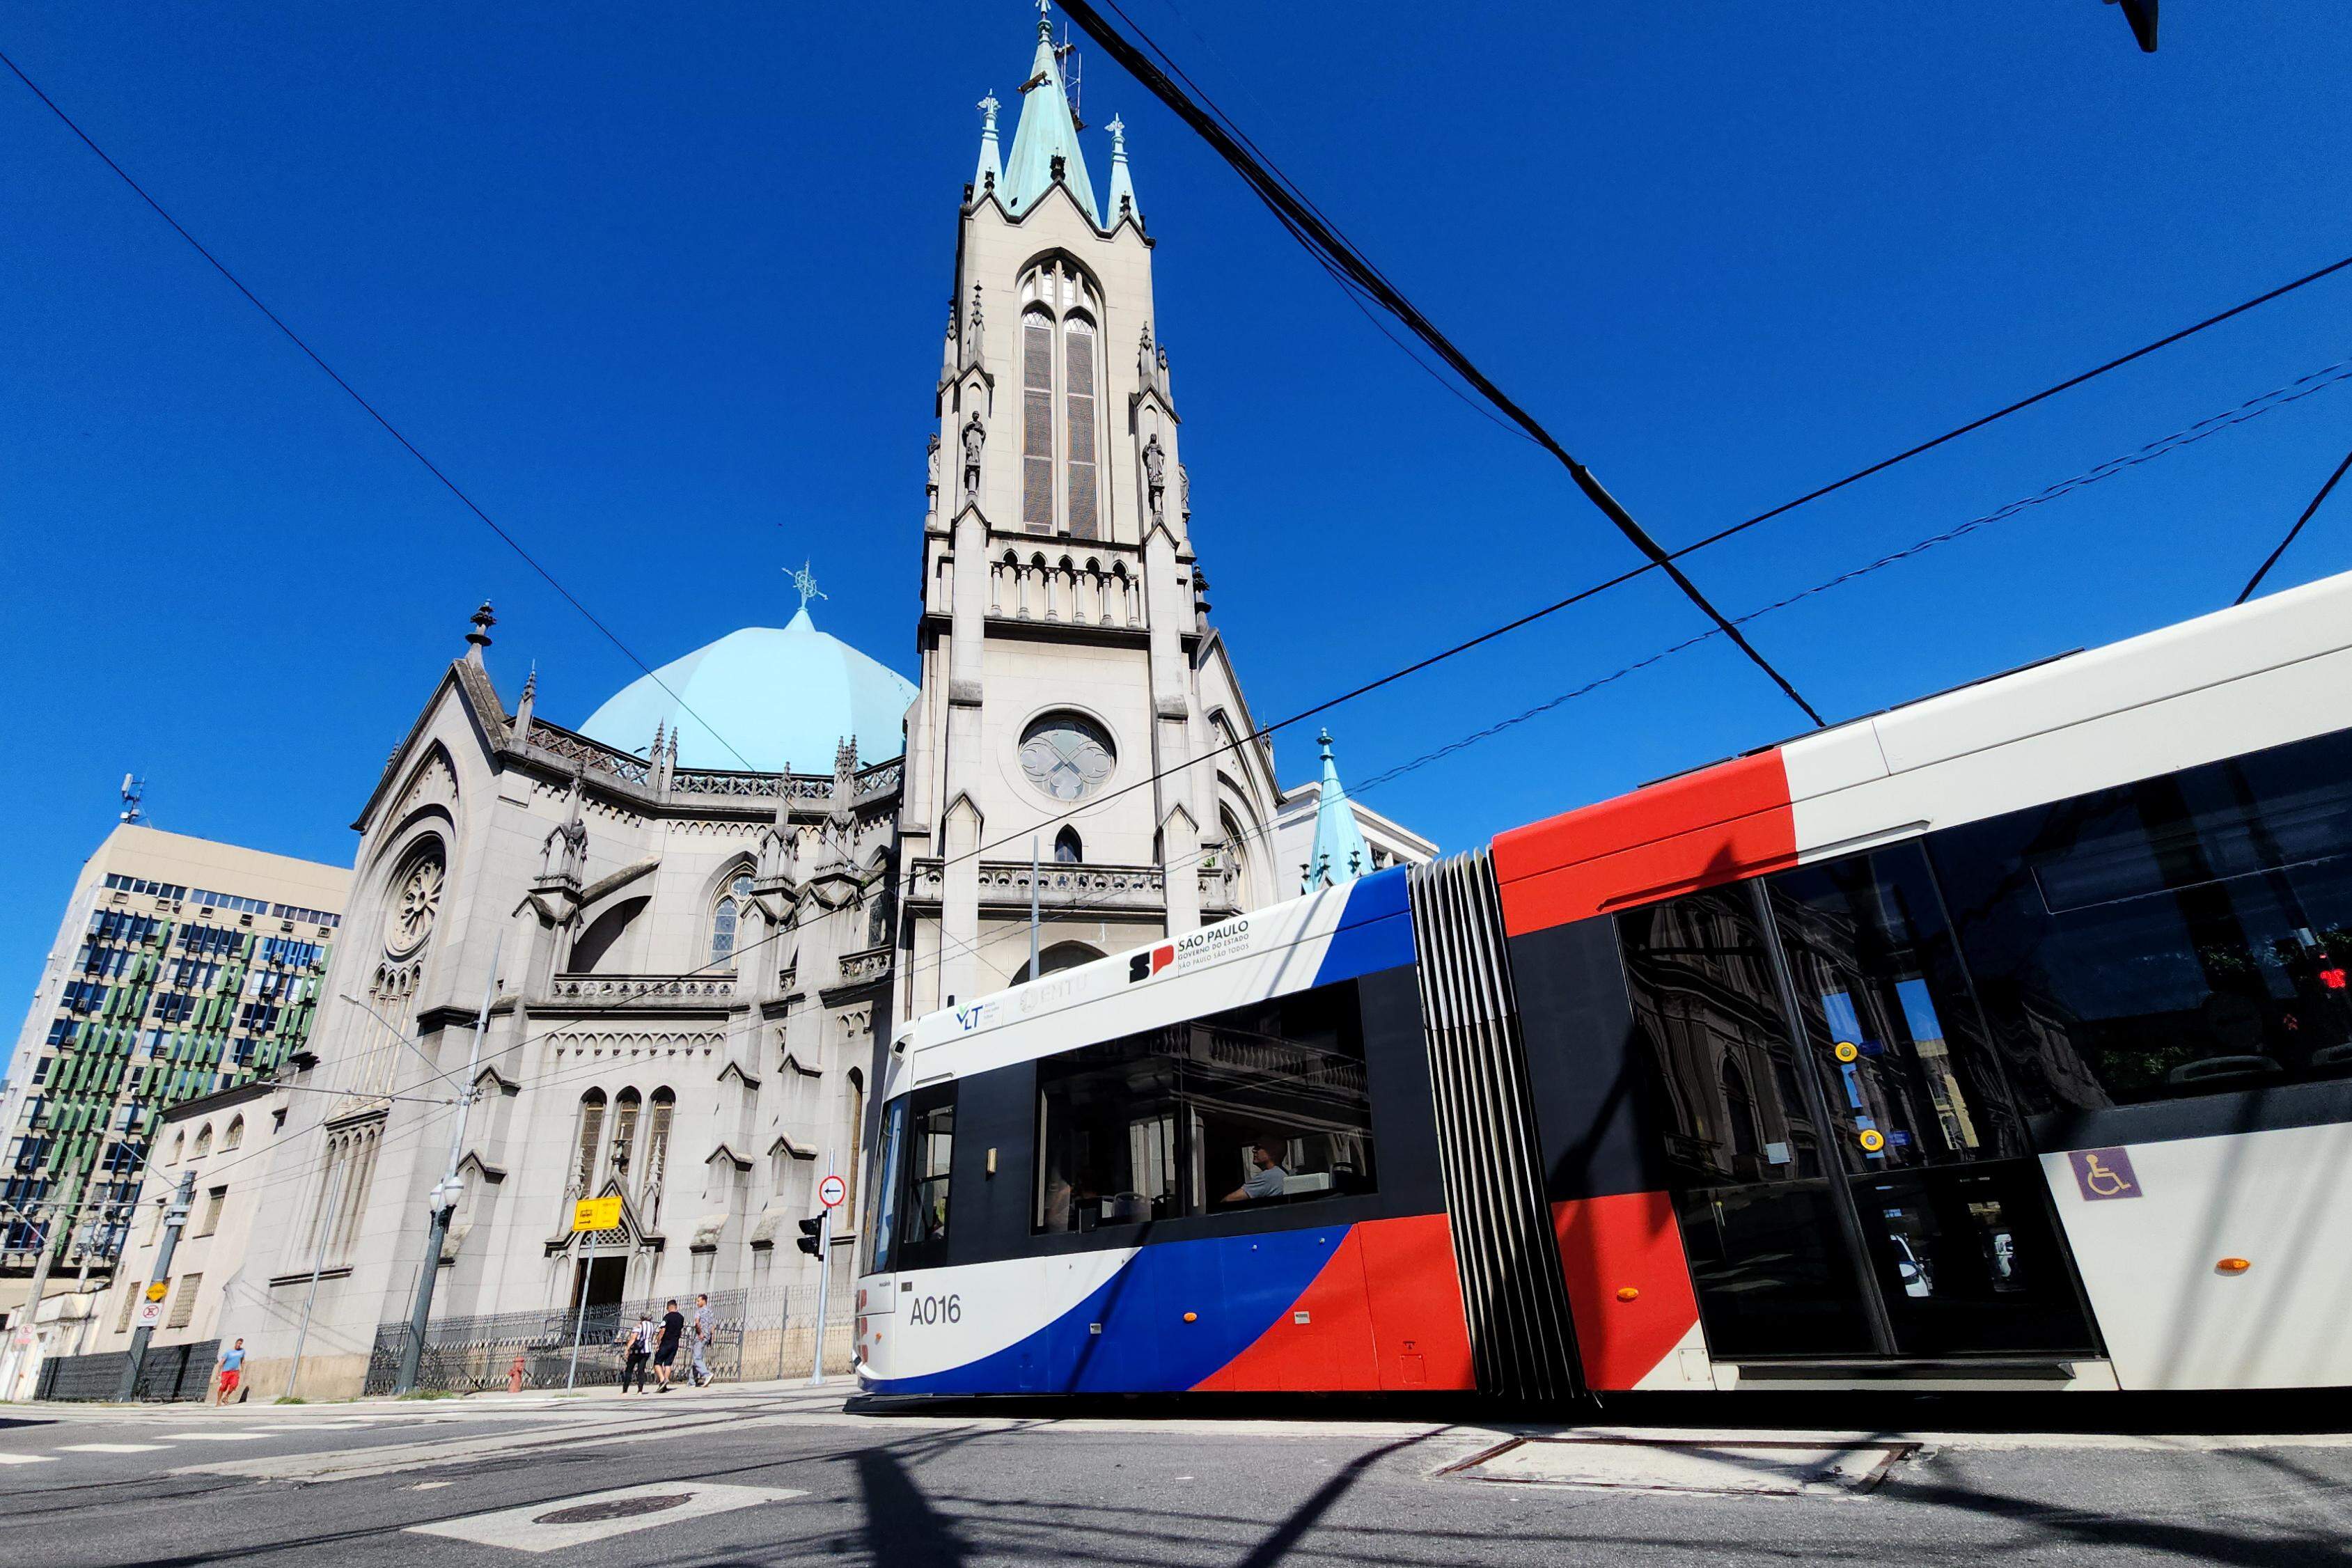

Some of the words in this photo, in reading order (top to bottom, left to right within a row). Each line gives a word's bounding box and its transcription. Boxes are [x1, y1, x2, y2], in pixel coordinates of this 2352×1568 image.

[1178, 946, 1210, 960] GOVERNO
[1224, 934, 1249, 946] ESTADO
[1179, 934, 1204, 952] SÃO
[1208, 920, 1248, 943] PAULO
[1193, 955, 1212, 965] PAULO
[1228, 943, 1249, 955] TODOS
[956, 1003, 984, 1031] VLT
[910, 1294, 961, 1326] A016
